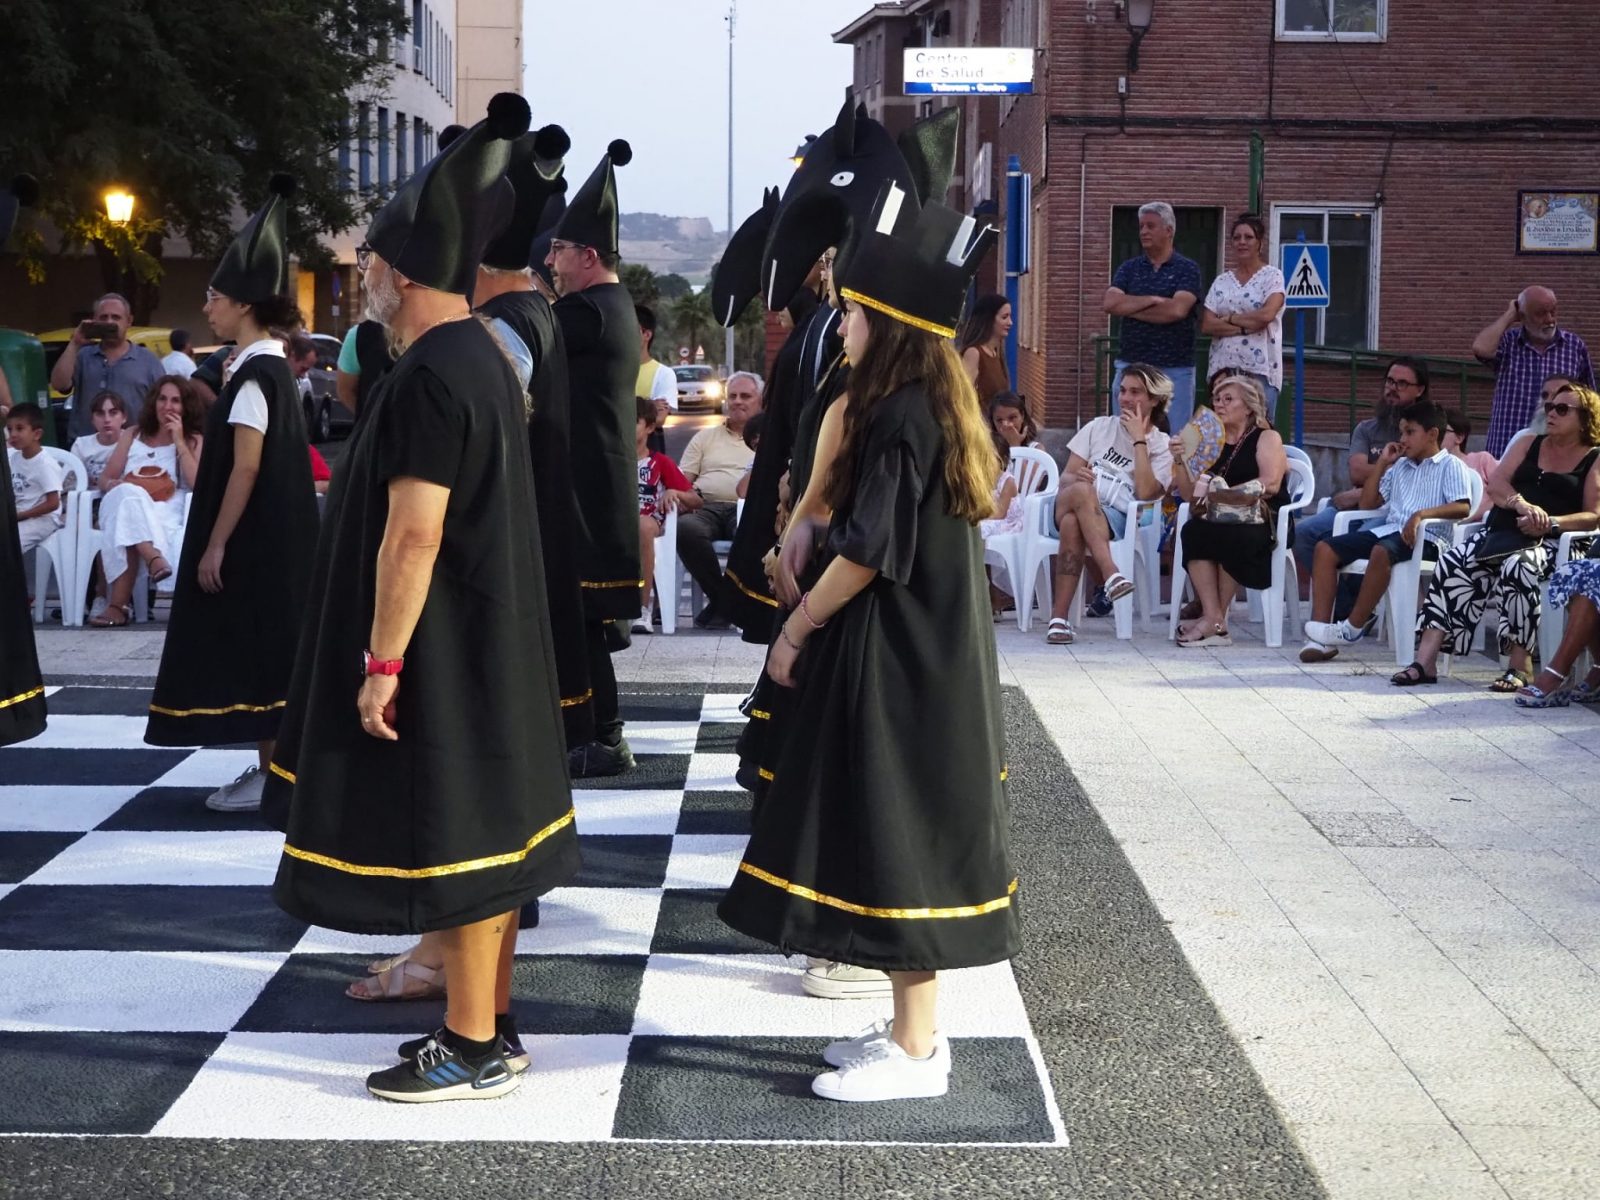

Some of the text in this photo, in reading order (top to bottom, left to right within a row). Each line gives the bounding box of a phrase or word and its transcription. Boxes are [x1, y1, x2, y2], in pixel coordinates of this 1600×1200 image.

[915, 52, 968, 64] Centro
[915, 67, 984, 78] de Salud
[1103, 447, 1132, 467] STAFF
